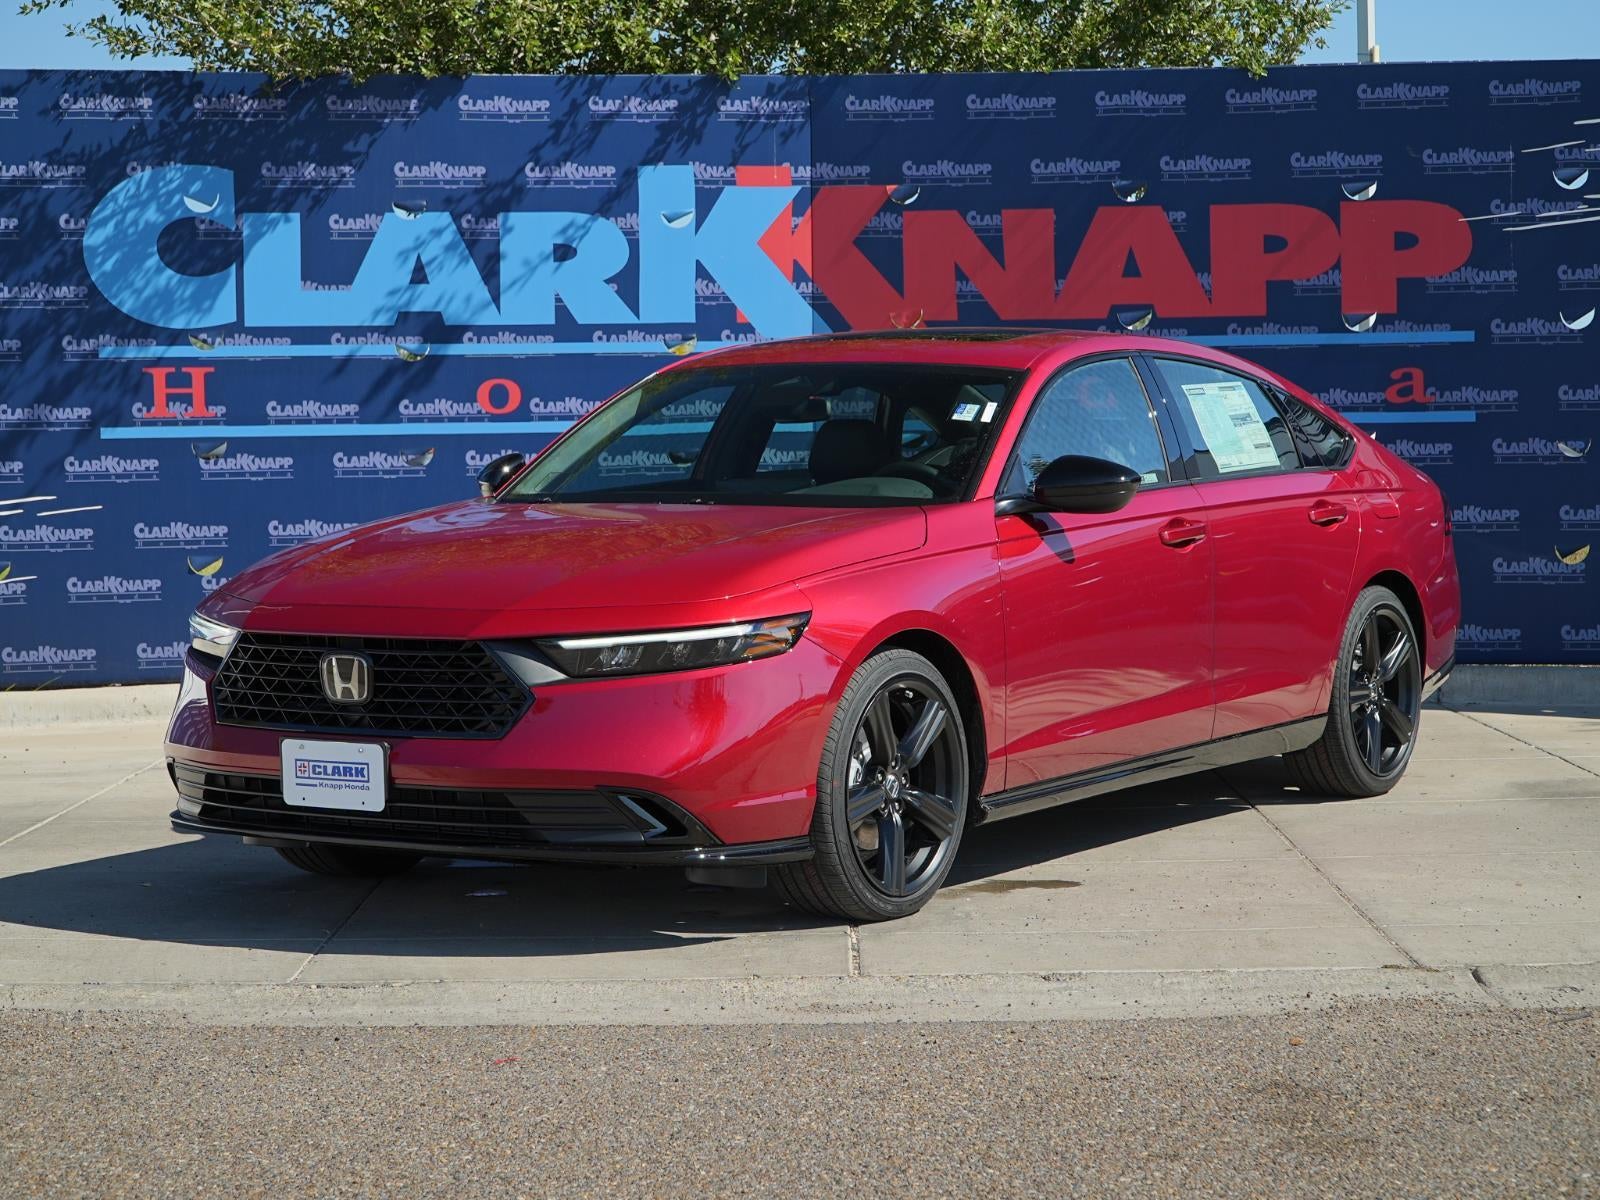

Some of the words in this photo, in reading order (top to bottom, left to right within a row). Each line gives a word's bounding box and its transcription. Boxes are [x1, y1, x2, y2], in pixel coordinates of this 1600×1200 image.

[311, 764, 366, 778] CLARK
[318, 782, 344, 790] Knapp
[345, 783, 370, 791] Honda
